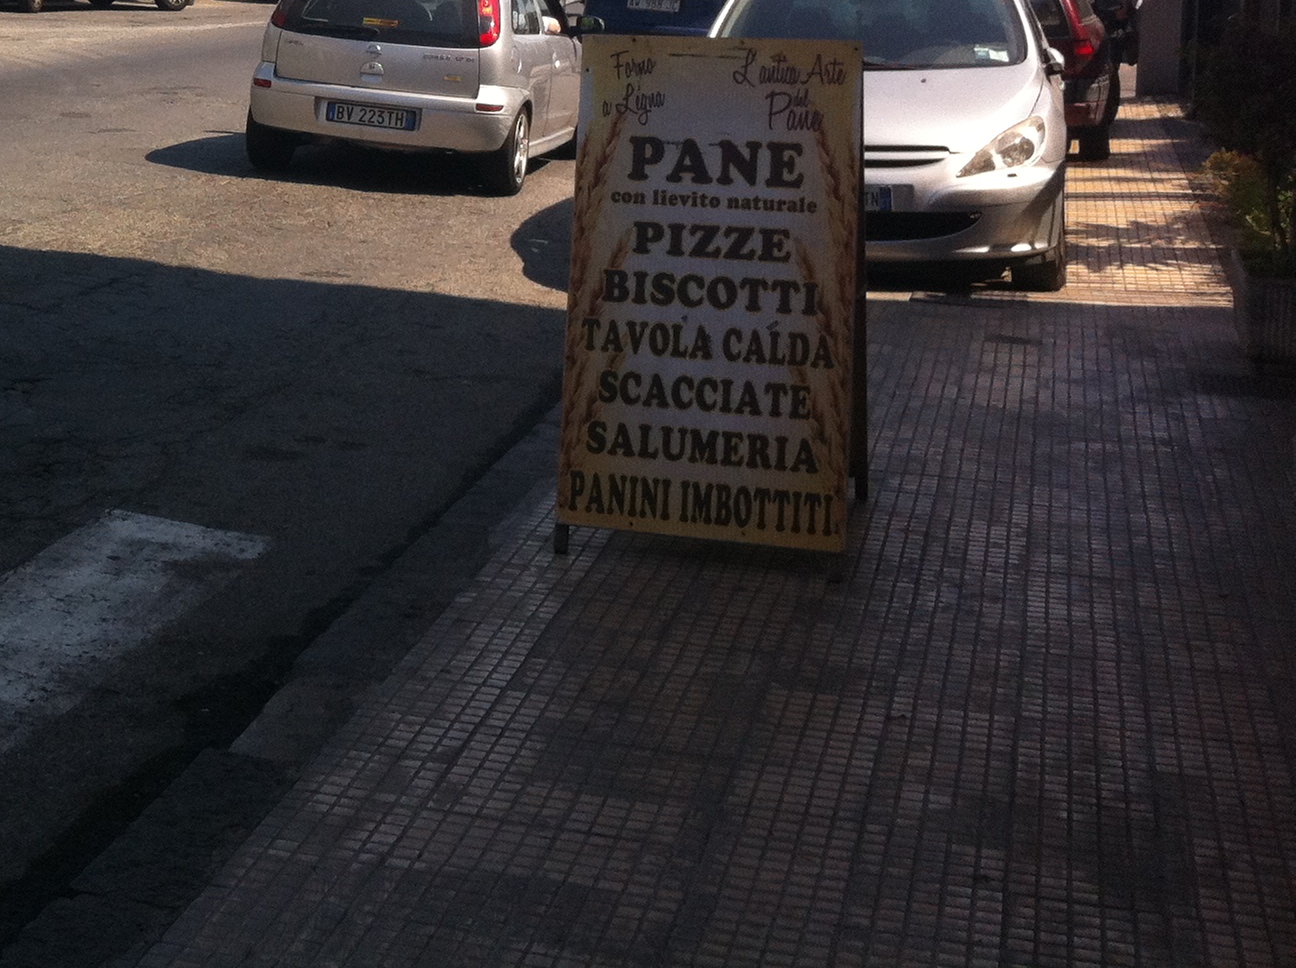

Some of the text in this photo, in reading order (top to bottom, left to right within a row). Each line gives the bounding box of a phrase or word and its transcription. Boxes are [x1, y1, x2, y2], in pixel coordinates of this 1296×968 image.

[610, 50, 656, 79] Forno
[801, 54, 847, 85] Arte
[336, 105, 404, 127] BV 223TH
[602, 100, 612, 117] a
[765, 90, 824, 131] Pane
[627, 135, 804, 189] PANE
[611, 190, 817, 214] con lievito naturale
[633, 221, 792, 263] PIZZE
[603, 269, 819, 317] BISCOTTI
[583, 317, 835, 369] TAVOLA CALDA
[599, 370, 811, 421] SCACCIATE
[587, 420, 818, 473] SALUMERIA
[568, 471, 834, 537] PANINI IMBOTTITI
